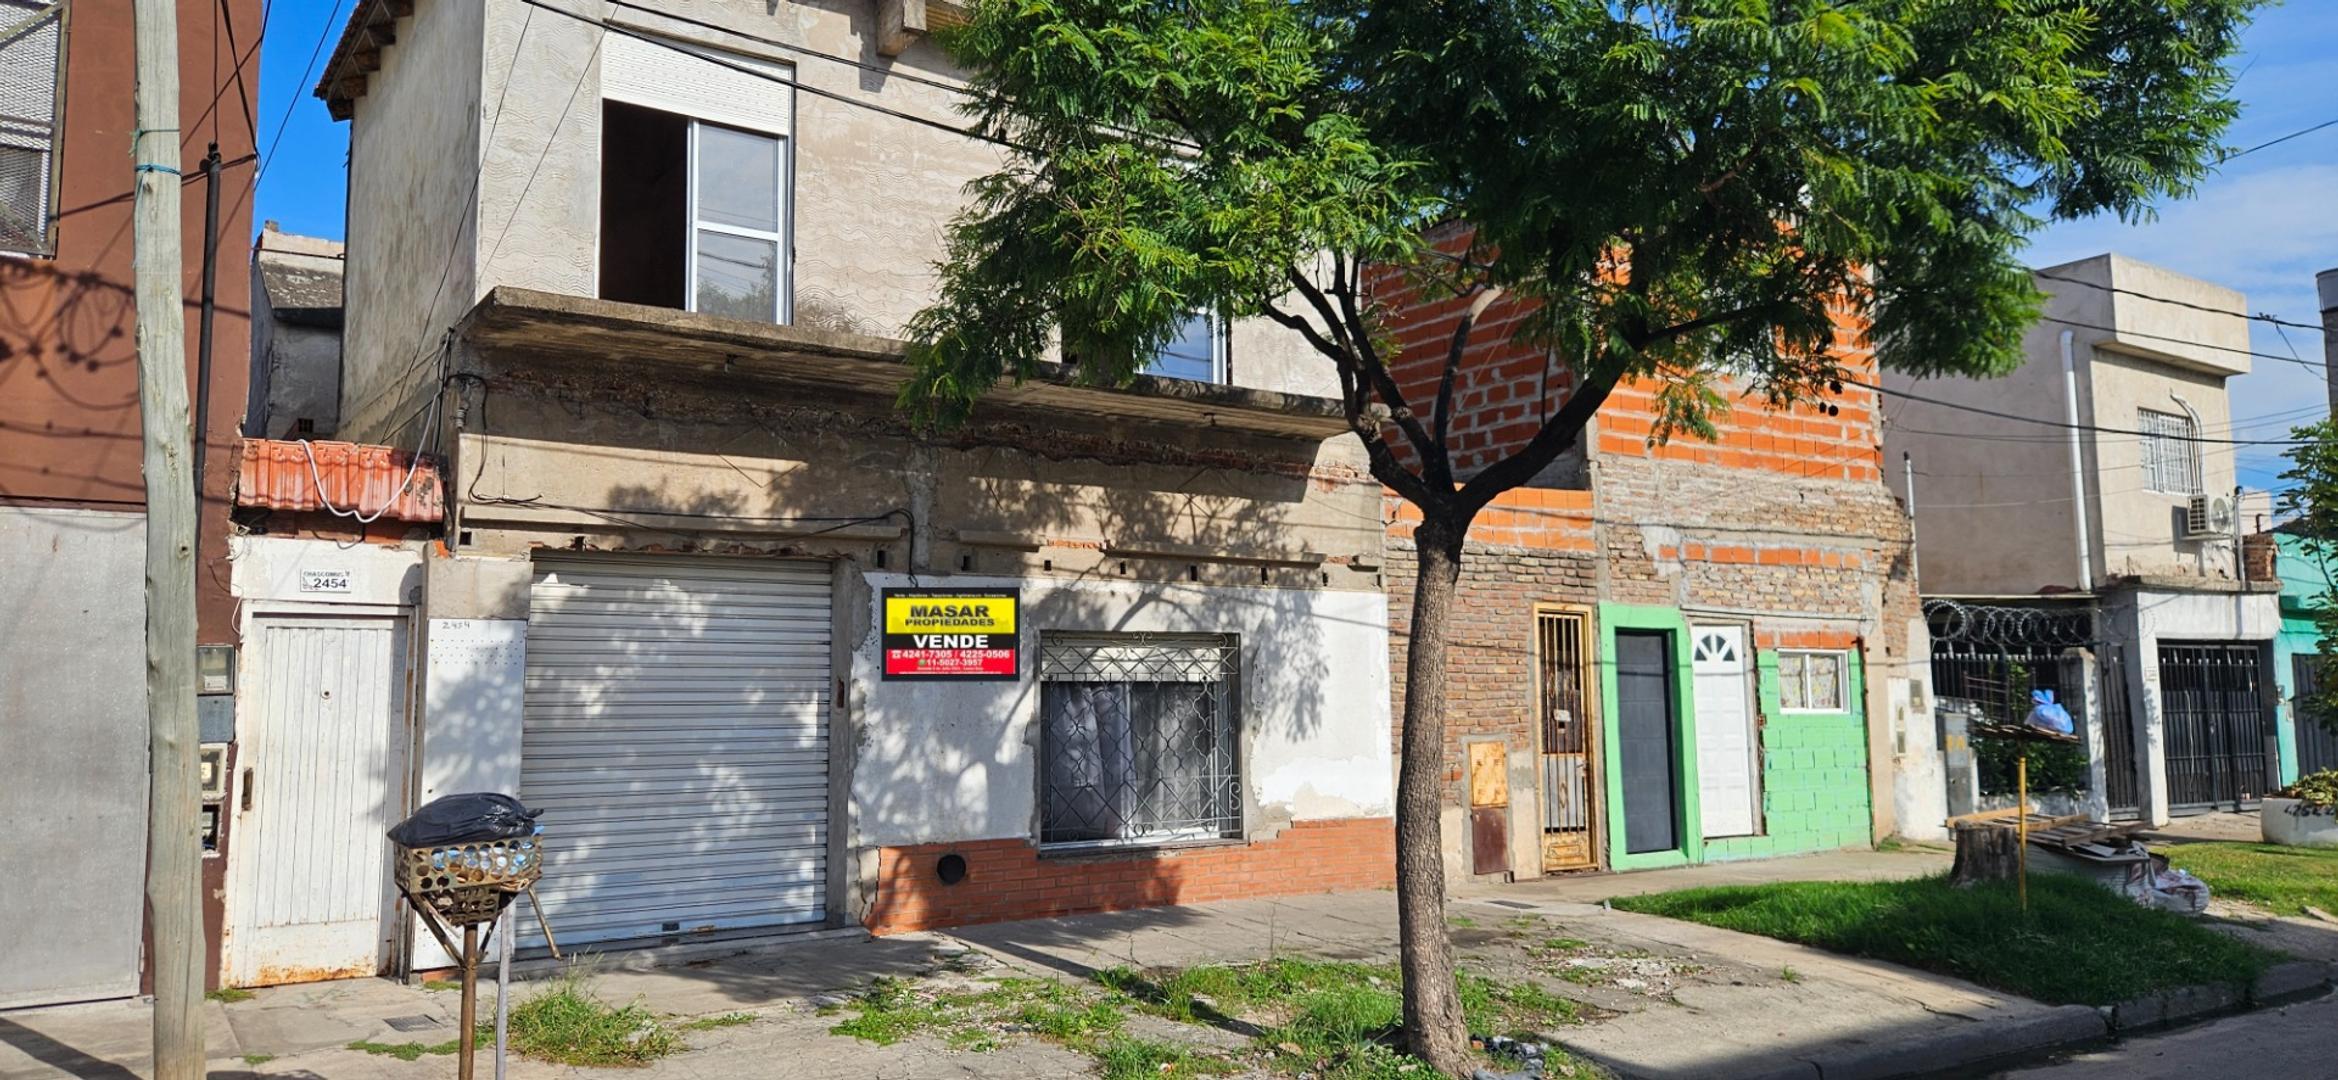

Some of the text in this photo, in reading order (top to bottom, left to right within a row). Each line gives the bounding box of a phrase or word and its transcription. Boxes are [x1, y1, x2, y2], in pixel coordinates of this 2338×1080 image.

[313, 578, 347, 588] 2454
[910, 605, 989, 617] MASAR
[905, 618, 995, 627] PROPIEDADES
[913, 634, 989, 648] VENDE
[902, 650, 953, 659] 4241-7305
[959, 650, 1010, 659] 4225-0506
